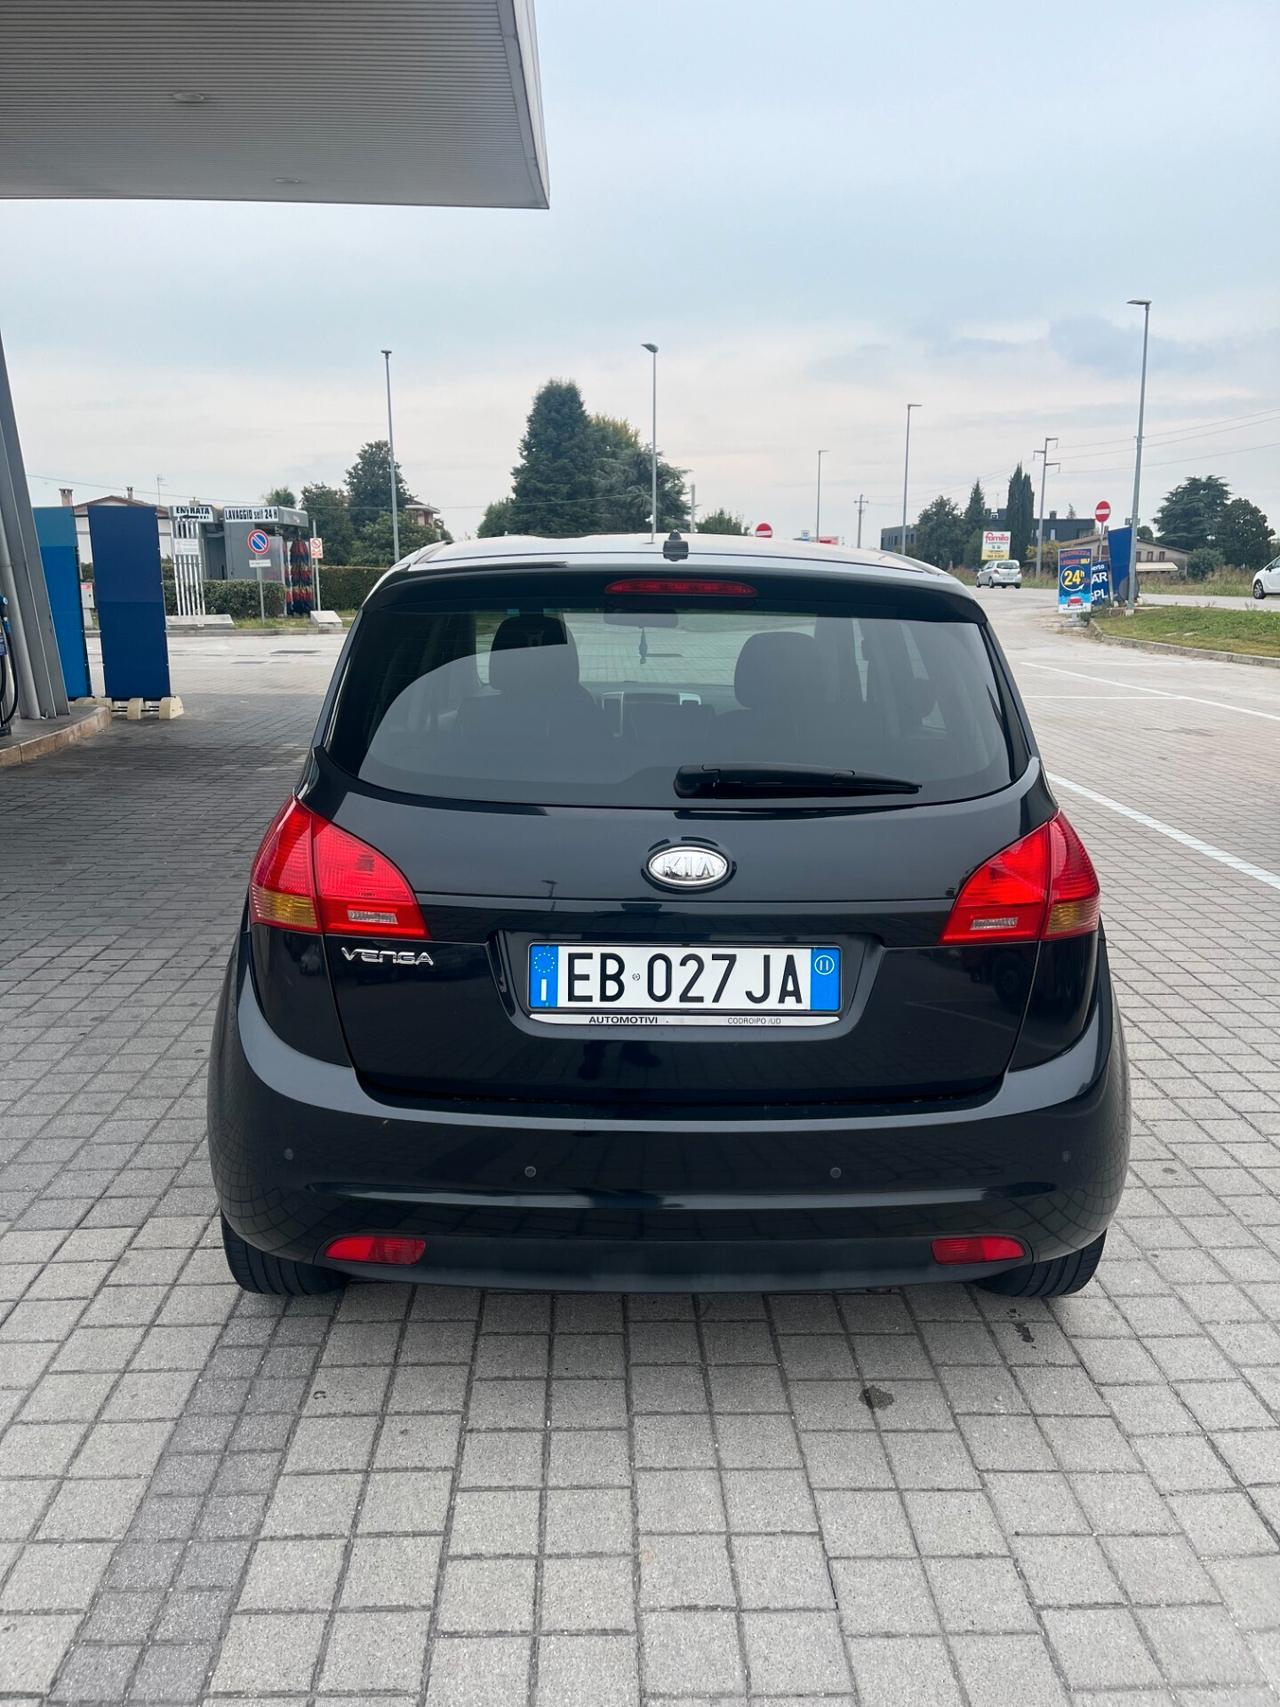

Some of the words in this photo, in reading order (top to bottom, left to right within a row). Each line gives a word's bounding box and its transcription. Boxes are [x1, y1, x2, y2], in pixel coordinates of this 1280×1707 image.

[225, 509, 253, 520] LAVAGGIO
[264, 508, 273, 519] 24
[1091, 571, 1108, 584] AR
[567, 952, 626, 1003] EB
[647, 953, 737, 1004] 027
[745, 954, 803, 1004] JA
[589, 1015, 658, 1025] AUTOMOTIVI
